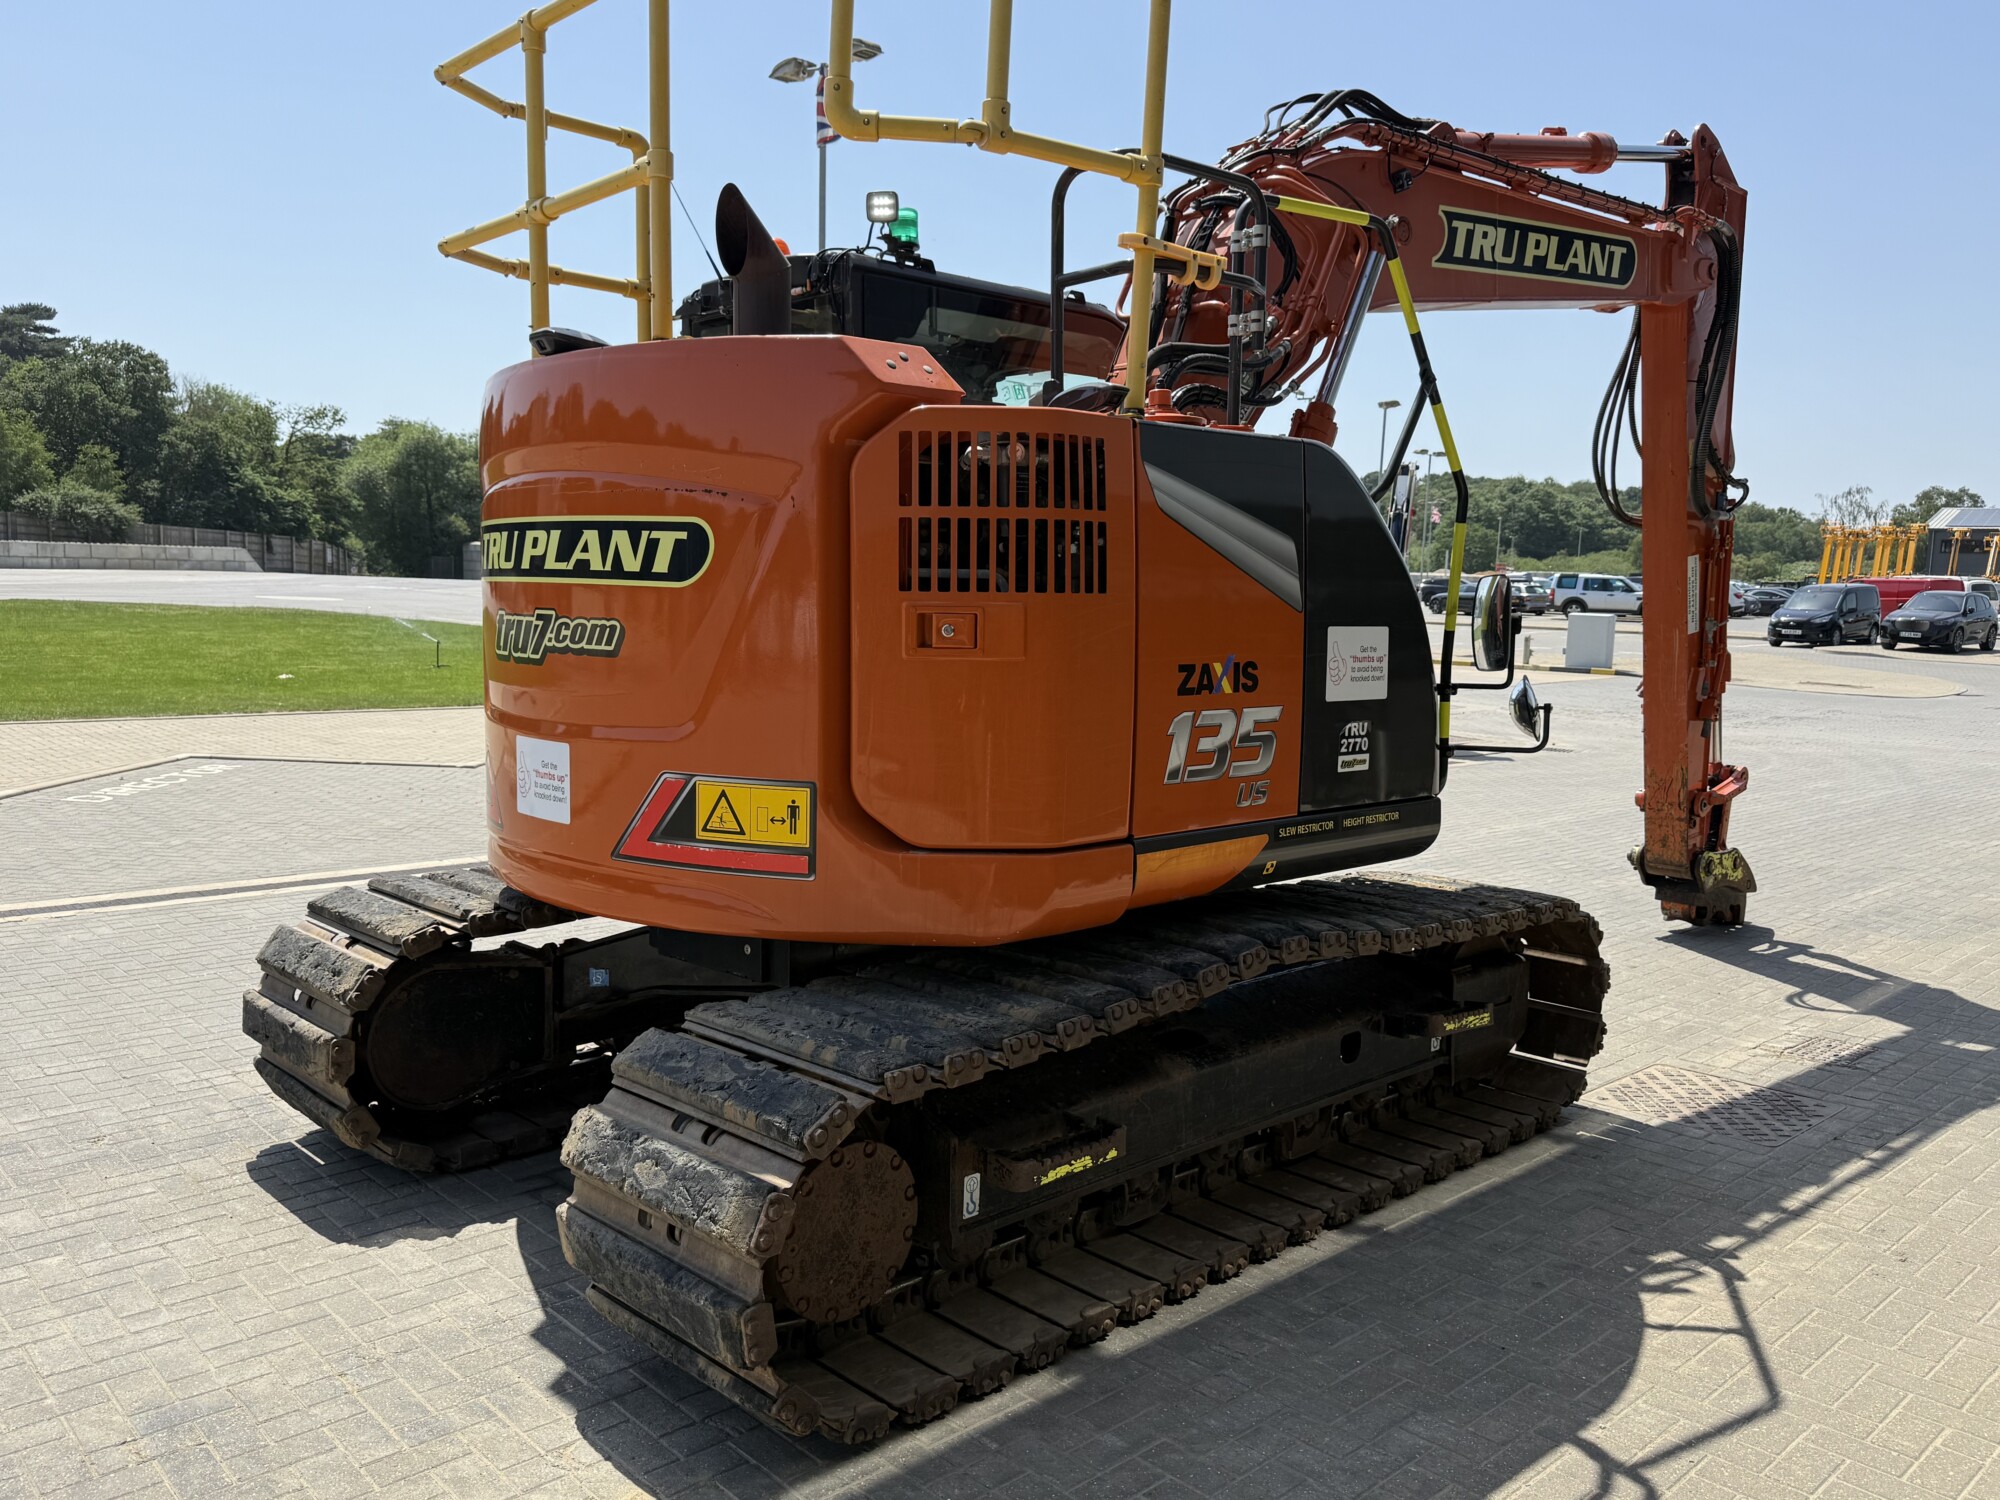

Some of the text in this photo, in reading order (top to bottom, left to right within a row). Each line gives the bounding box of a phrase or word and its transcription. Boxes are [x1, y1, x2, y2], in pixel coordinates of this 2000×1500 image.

[1451, 220, 1627, 278] TRU PLANT
[483, 529, 688, 573] TRU PLANT
[495, 608, 624, 662] tru7.com
[1360, 645, 1369, 653] Get
[1177, 654, 1259, 696] ZAXIS
[1350, 674, 1370, 682] knocked
[1357, 665, 1370, 673] avoid
[1370, 665, 1384, 674] being
[1342, 722, 1368, 737] TRU
[1163, 705, 1284, 785] 135
[1340, 737, 1369, 753] 2770
[541, 760, 549, 769] Get
[60, 764, 243, 803] DIRECTOR
[534, 780, 565, 795] to avoid being
[534, 791, 551, 801] knocked
[1235, 780, 1271, 808] US
[1343, 811, 1400, 828] HEIGHT RESTRICTOR
[1279, 820, 1334, 838] SLEW RESTRICTOR
